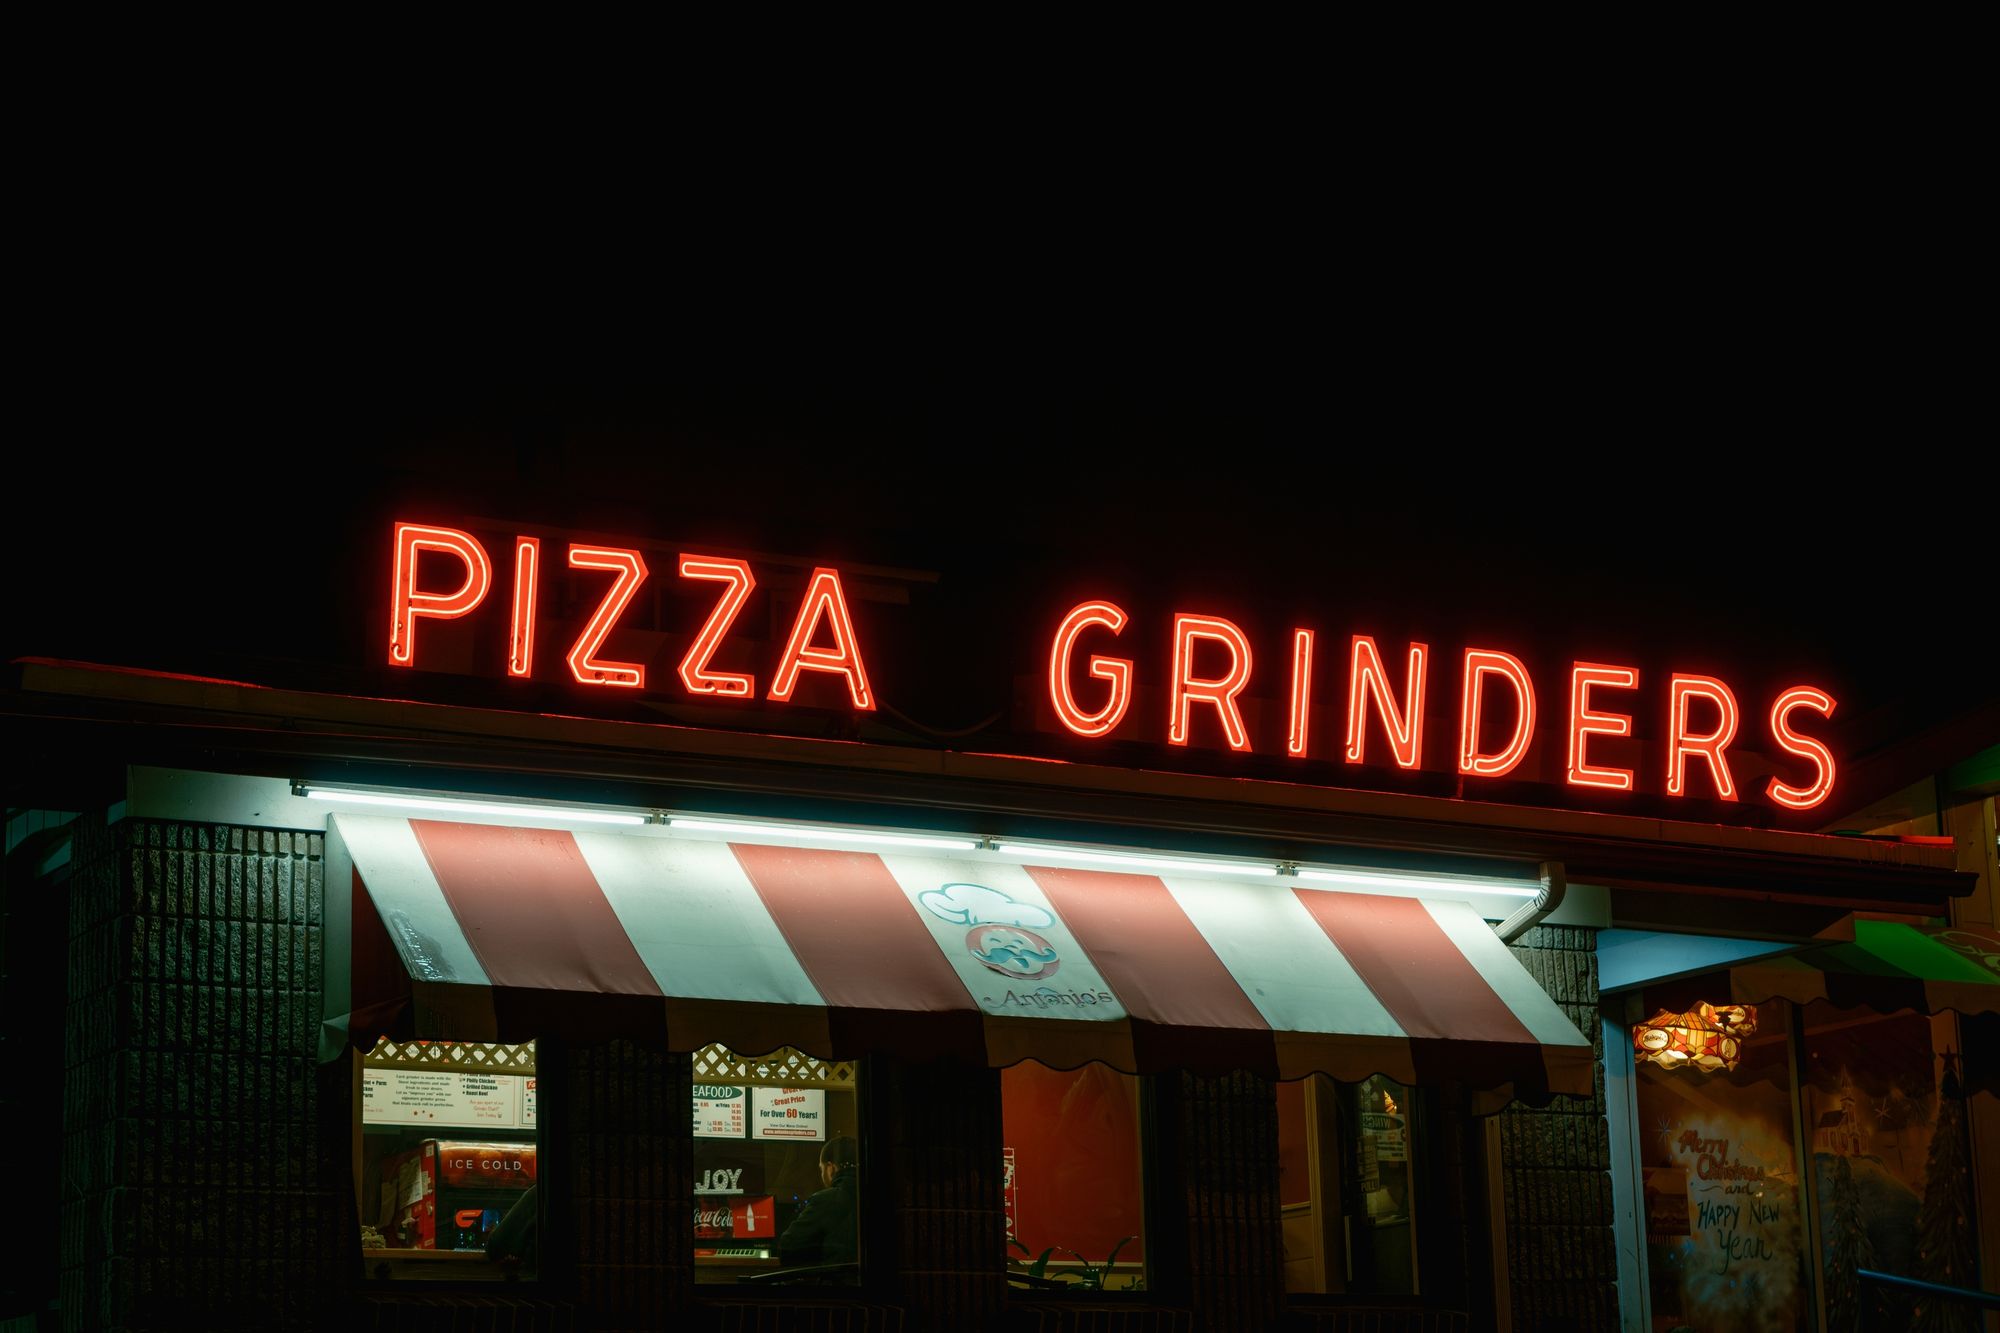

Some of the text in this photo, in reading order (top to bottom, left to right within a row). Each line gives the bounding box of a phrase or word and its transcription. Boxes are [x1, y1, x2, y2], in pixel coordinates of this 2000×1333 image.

[388, 521, 1838, 810] PIZZA GRINDERS
[984, 988, 1113, 1008] Antonio's
[693, 1085, 733, 1098] EAFOOD
[774, 1096, 806, 1106] Great Price
[760, 1108, 818, 1119] For Over 60 Years!
[1678, 1129, 1729, 1162] Merry
[449, 1159, 522, 1171] ICE COLD
[1725, 1184, 1754, 1196] and
[1697, 1200, 1780, 1230] HAPPY NEW
[1718, 1229, 1773, 1276] Year
